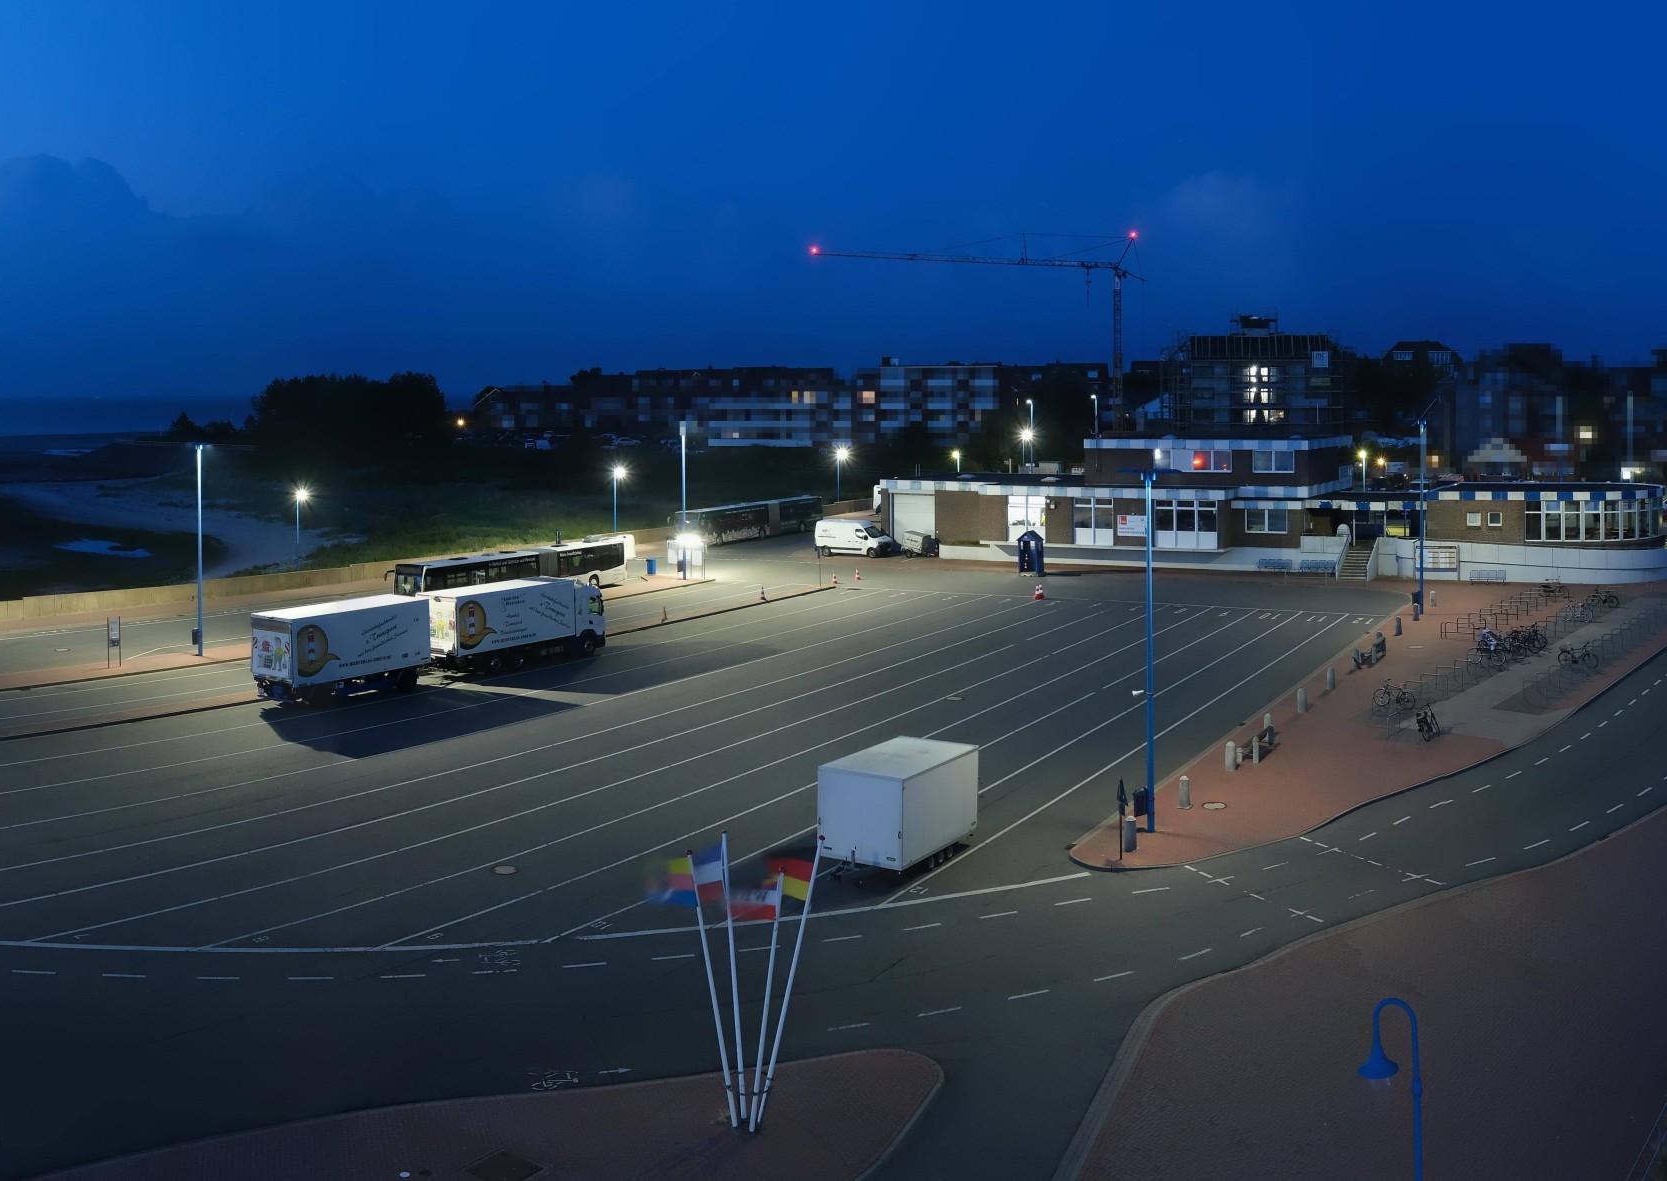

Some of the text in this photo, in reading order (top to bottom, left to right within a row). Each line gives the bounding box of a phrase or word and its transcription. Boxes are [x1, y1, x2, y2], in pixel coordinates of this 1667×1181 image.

[543, 601, 566, 618] Transport
[1258, 612, 1282, 620] 10
[1306, 615, 1328, 623] 11
[1351, 617, 1375, 625] 12
[369, 624, 397, 641] Transport
[908, 884, 930, 896] 12
